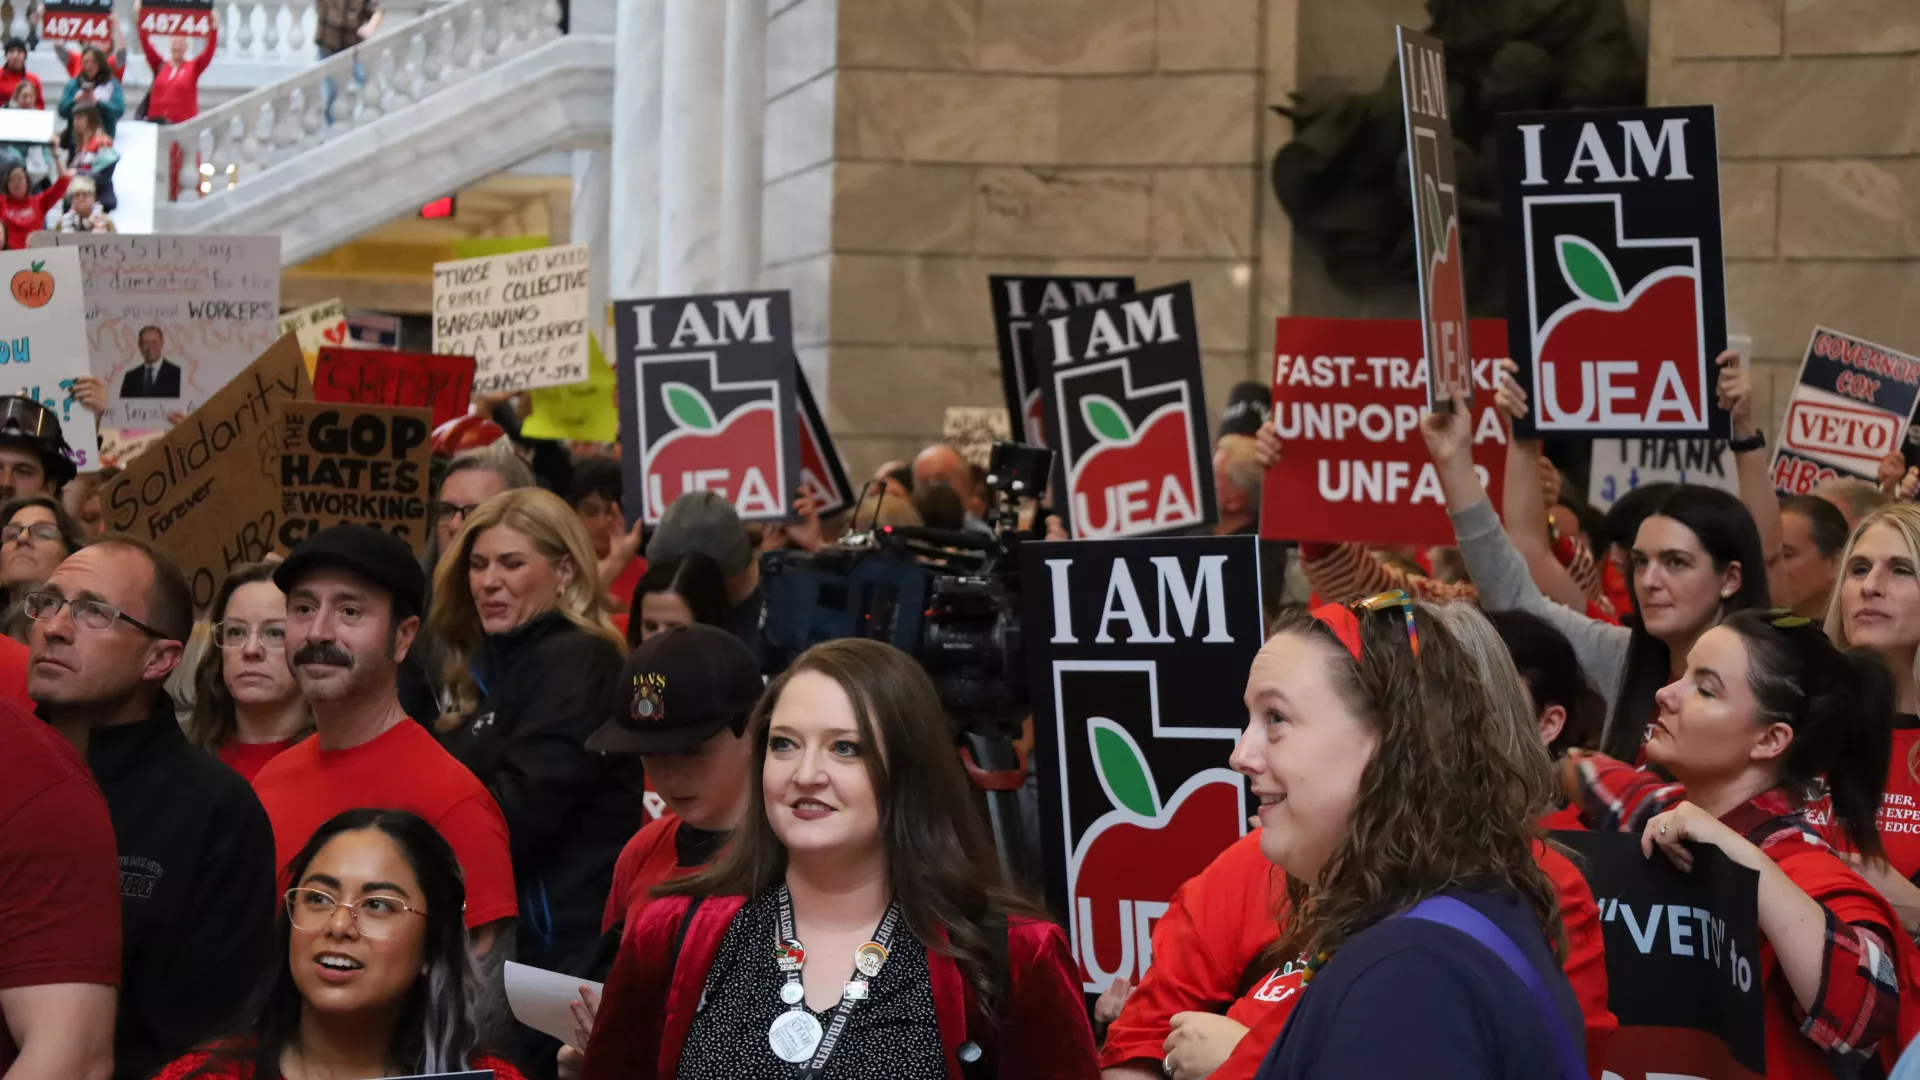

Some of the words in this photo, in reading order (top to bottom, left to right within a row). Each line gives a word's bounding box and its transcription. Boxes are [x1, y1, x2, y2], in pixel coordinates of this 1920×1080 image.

[1405, 42, 1419, 112] I
[1420, 47, 1447, 120] AM
[1517, 124, 1549, 185] I
[1564, 118, 1695, 184] AM
[502, 267, 590, 303] COLLECTIVE
[505, 253, 540, 277] WHO
[188, 300, 275, 320] WORKERS
[1004, 280, 1026, 317] I
[500, 317, 588, 350] DISSERVICE
[632, 304, 657, 350] I
[669, 298, 776, 350] AM
[1047, 316, 1074, 367] I
[1084, 293, 1181, 360] AM
[501, 346, 551, 370] CAUSE
[1541, 360, 1702, 424] UEA
[1836, 369, 1881, 403] COX
[111, 366, 300, 532] Solidarity
[308, 411, 426, 460] GOP
[1799, 412, 1887, 449] VETO
[281, 454, 419, 494] HATES
[148, 477, 216, 540] Forever
[299, 492, 425, 520] WORKING
[1074, 473, 1198, 538] UEA
[1045, 558, 1079, 644] I
[1095, 555, 1235, 644] AM
[1730, 939, 1752, 993] to
[811, 1015, 847, 1070] CLEARFIELD
